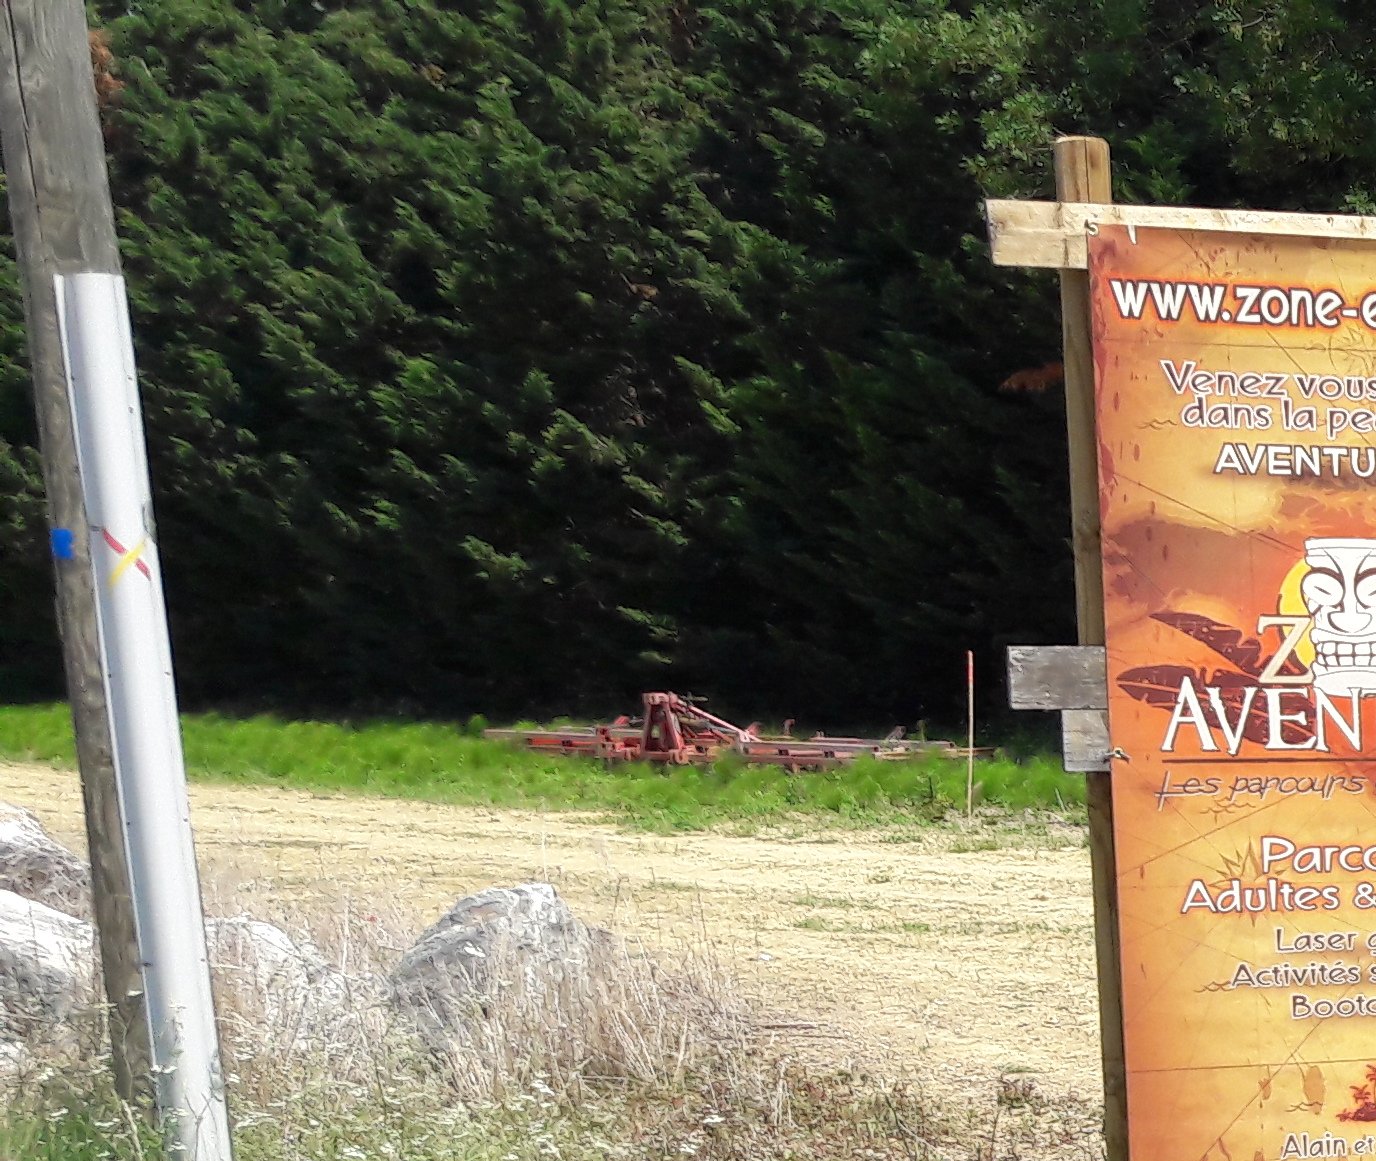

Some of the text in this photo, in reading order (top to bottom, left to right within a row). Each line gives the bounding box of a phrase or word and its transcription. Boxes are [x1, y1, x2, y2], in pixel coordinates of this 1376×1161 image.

[1160, 359, 1286, 398] Venez
[1182, 396, 1270, 430] dans
[1282, 400, 1317, 432] la
[1154, 771, 1222, 812] Les
[1229, 773, 1368, 801] parcours
[1179, 878, 1339, 915] Adultes
[1275, 927, 1357, 954] Laser
[1230, 961, 1361, 989] Activités
[1280, 1133, 1349, 1160] Alain
[1353, 1136, 1376, 1156] et
